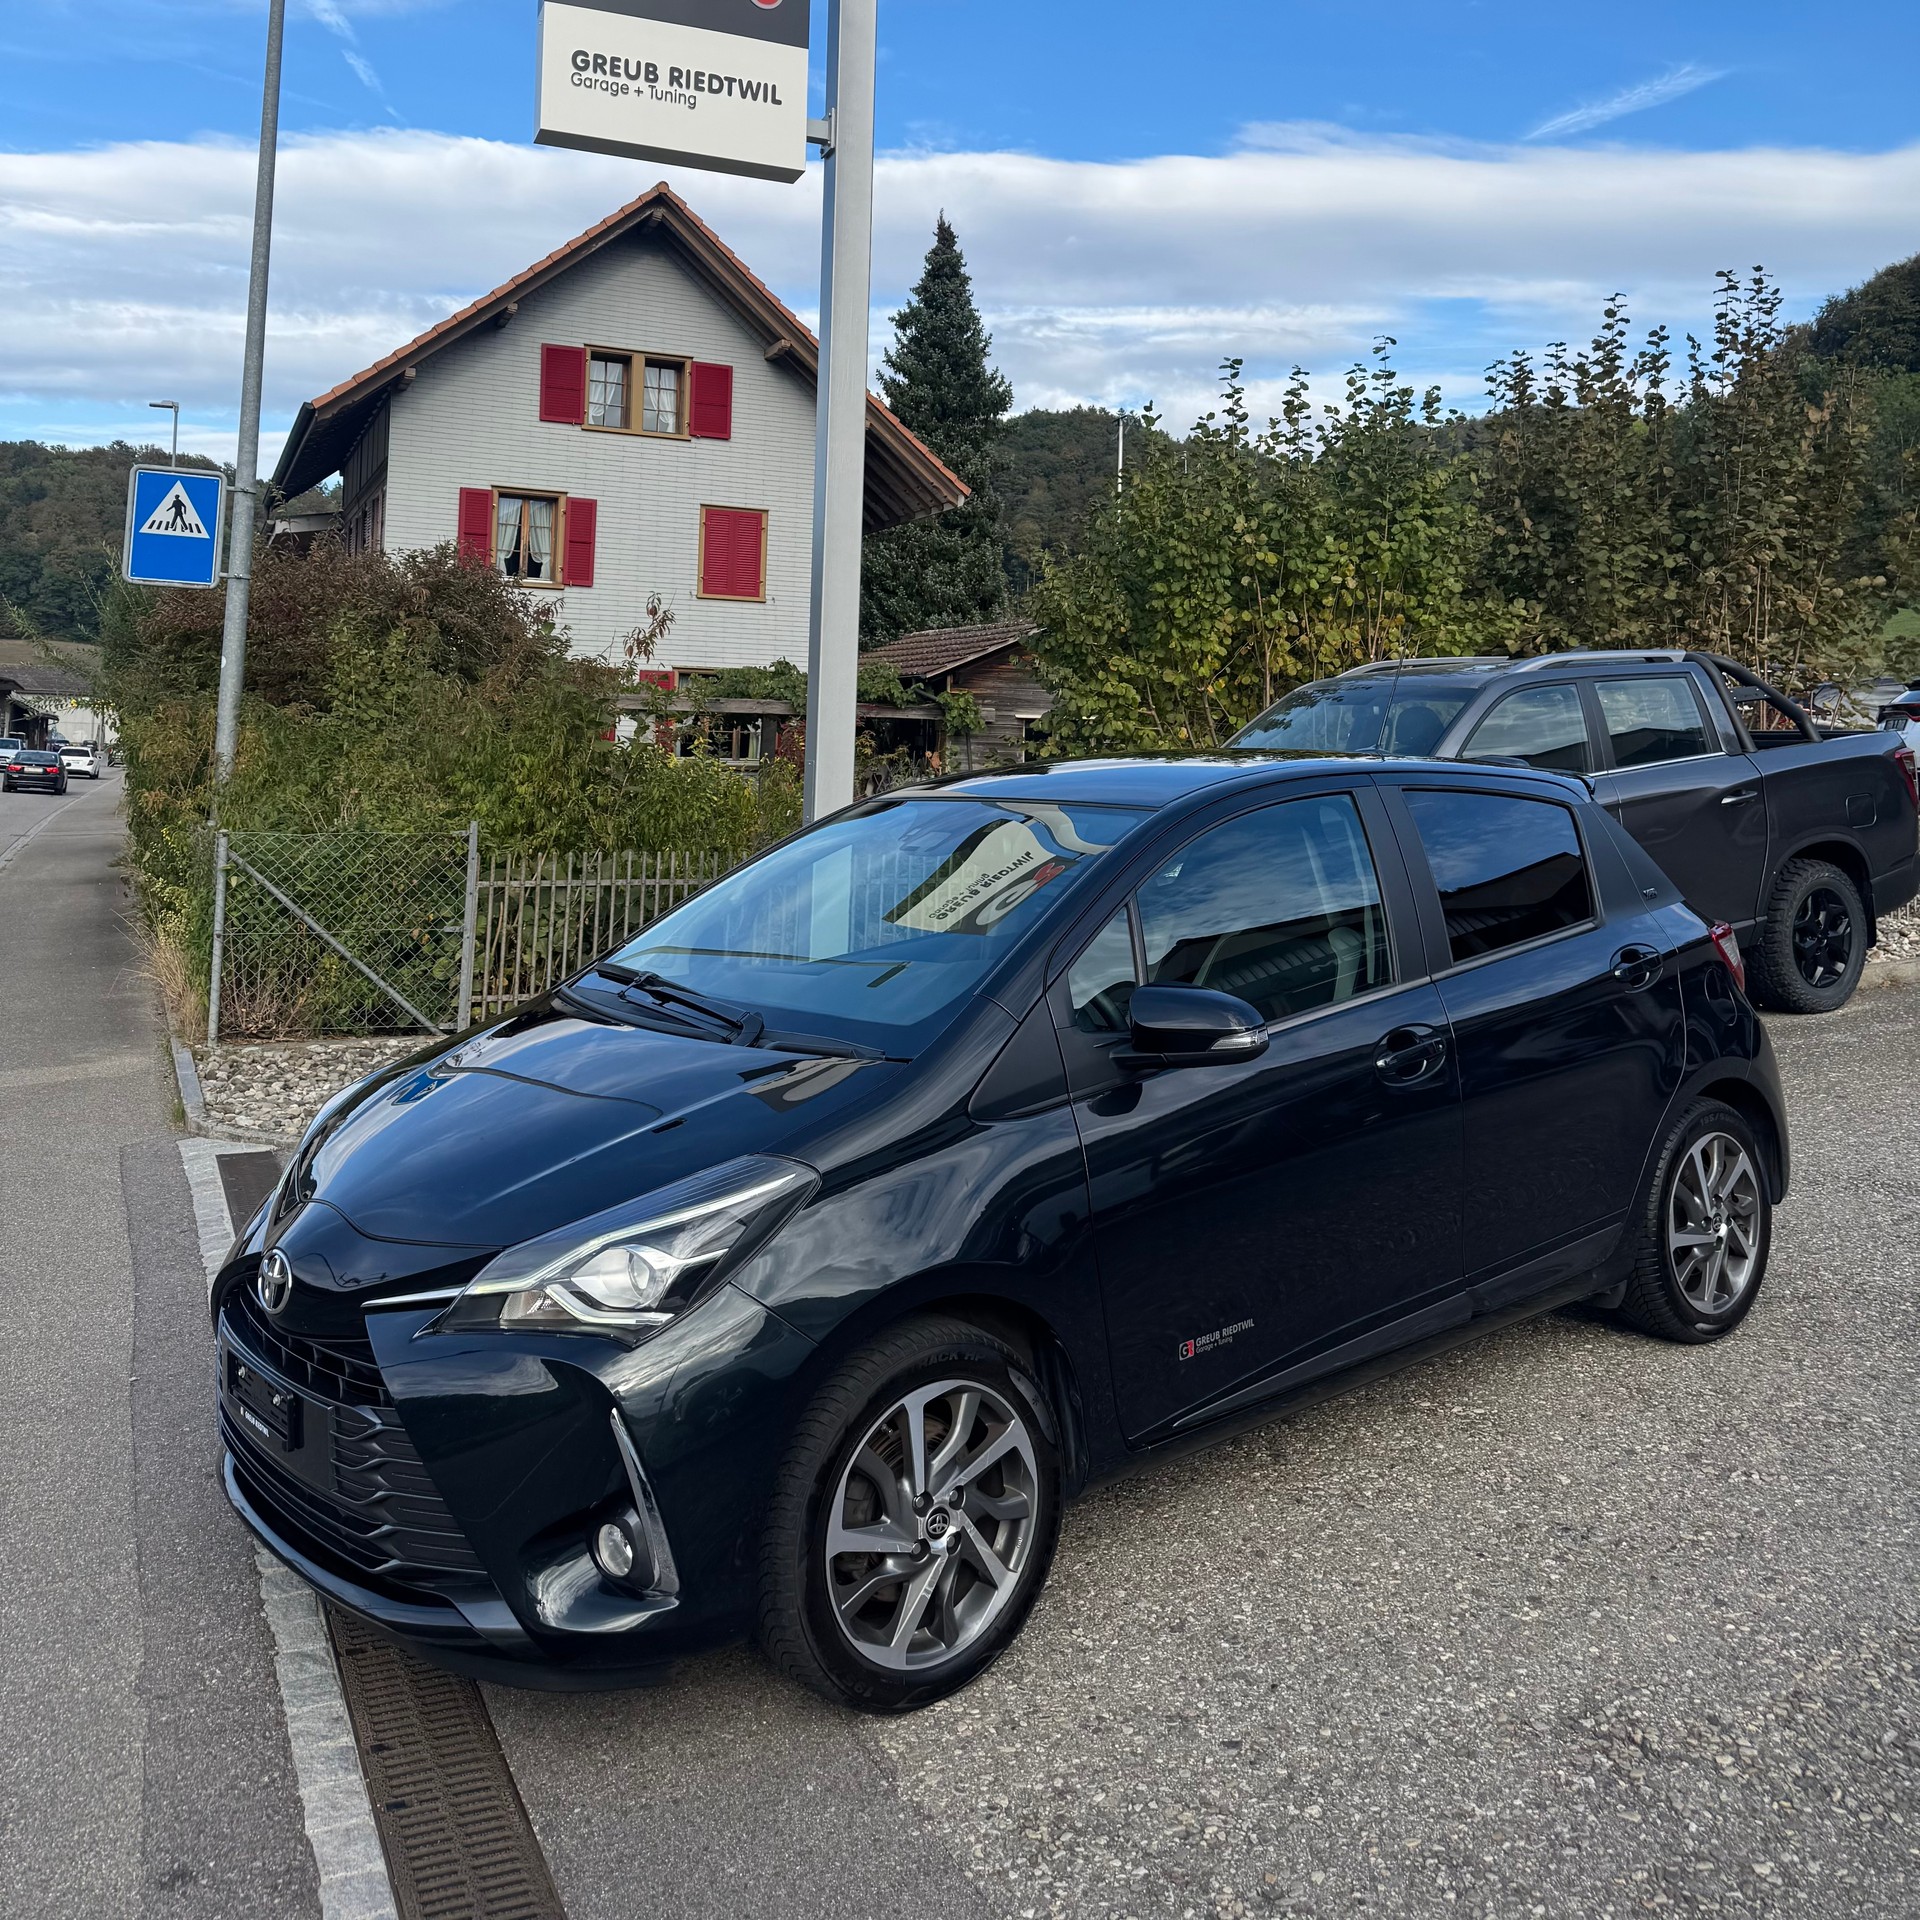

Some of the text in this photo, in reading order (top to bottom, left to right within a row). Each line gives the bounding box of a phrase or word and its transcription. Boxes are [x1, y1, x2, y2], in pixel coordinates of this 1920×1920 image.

[570, 71, 697, 109] Garage + Tuning
[571, 49, 782, 106] GREUB RIEDTWIL
[1196, 1318, 1255, 1347] GREUB RIEDTWIL
[1196, 1343, 1213, 1354] Garage
[1218, 1335, 1233, 1345] Tuning
